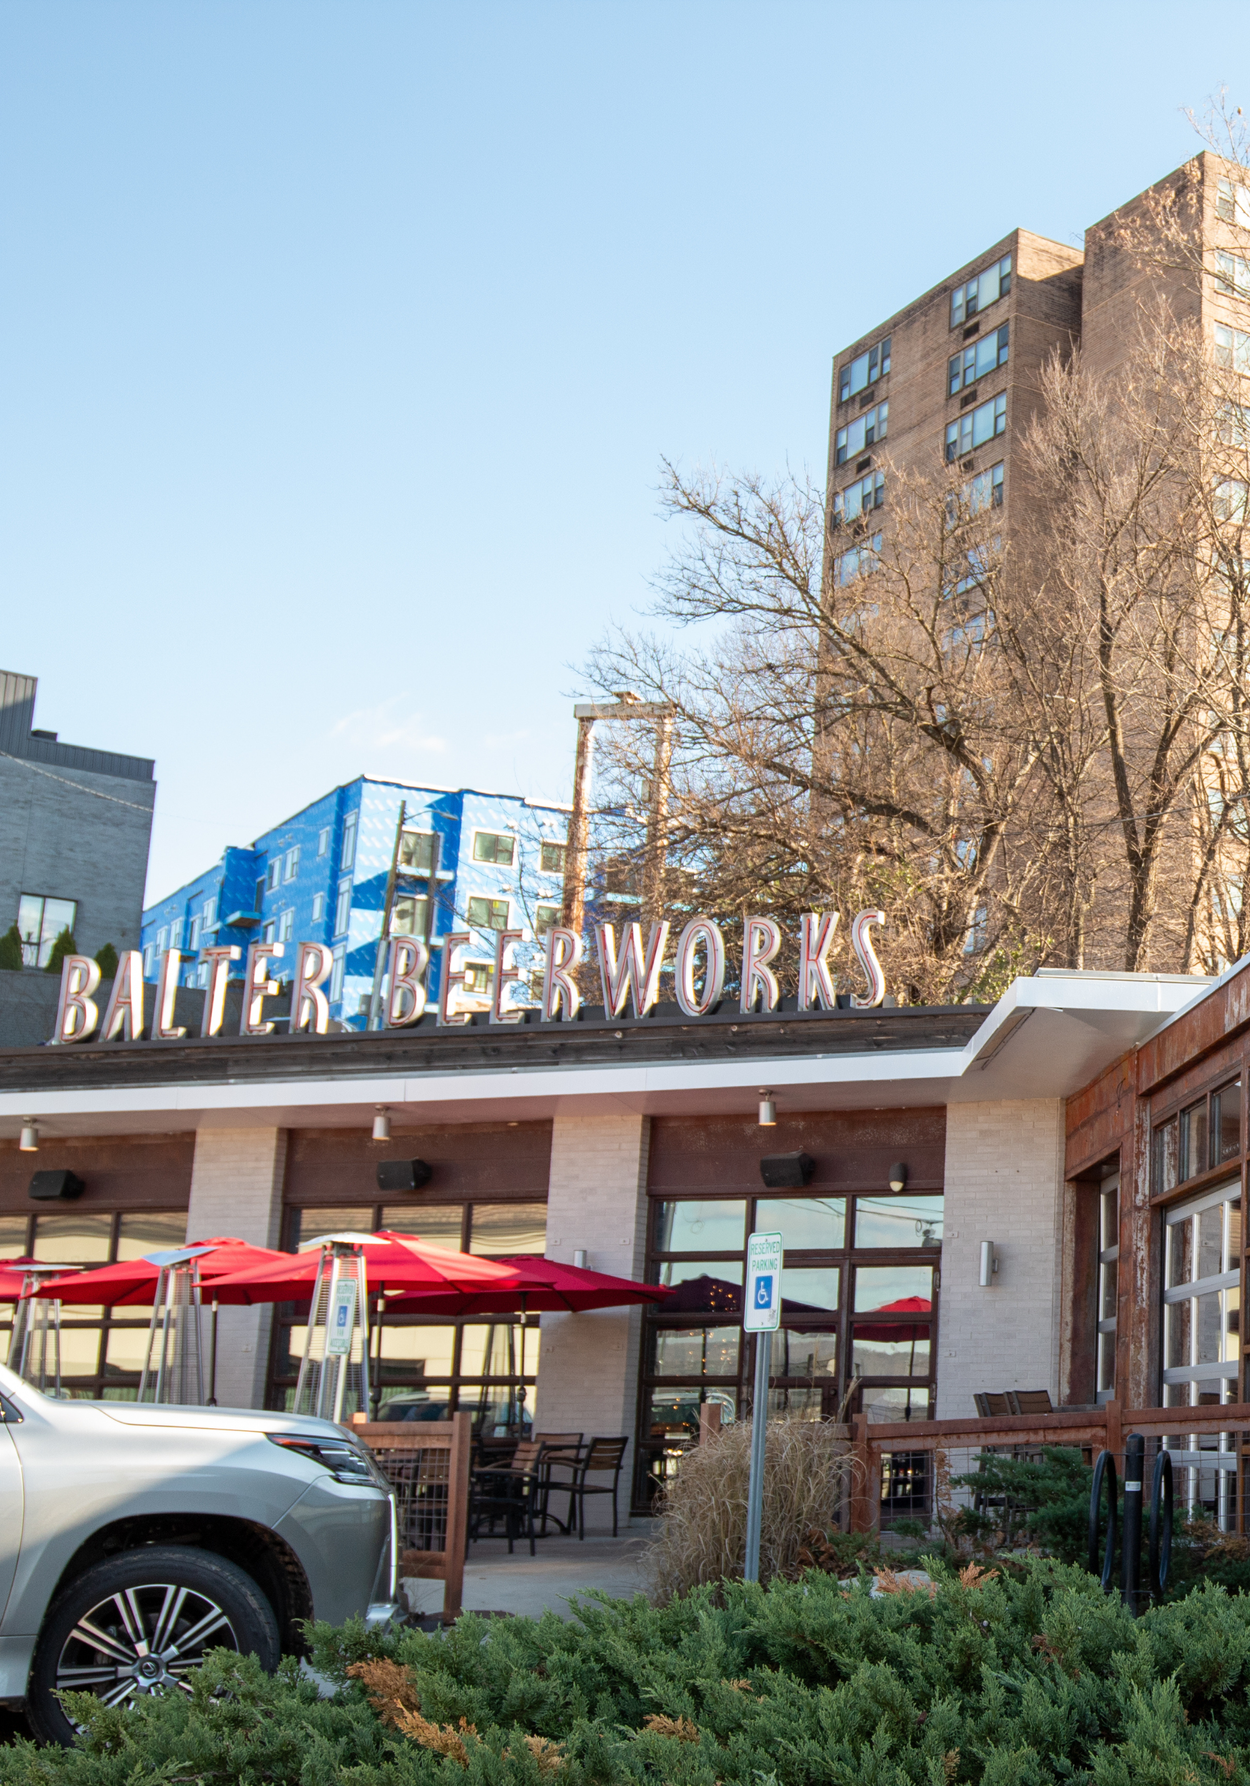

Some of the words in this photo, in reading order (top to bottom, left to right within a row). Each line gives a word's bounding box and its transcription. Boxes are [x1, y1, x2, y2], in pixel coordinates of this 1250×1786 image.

[52, 942, 334, 1045] BALTER
[384, 908, 886, 1030] BEERWORKS
[750, 1241, 780, 1256] RESERVED
[751, 1258, 778, 1272] PARKING
